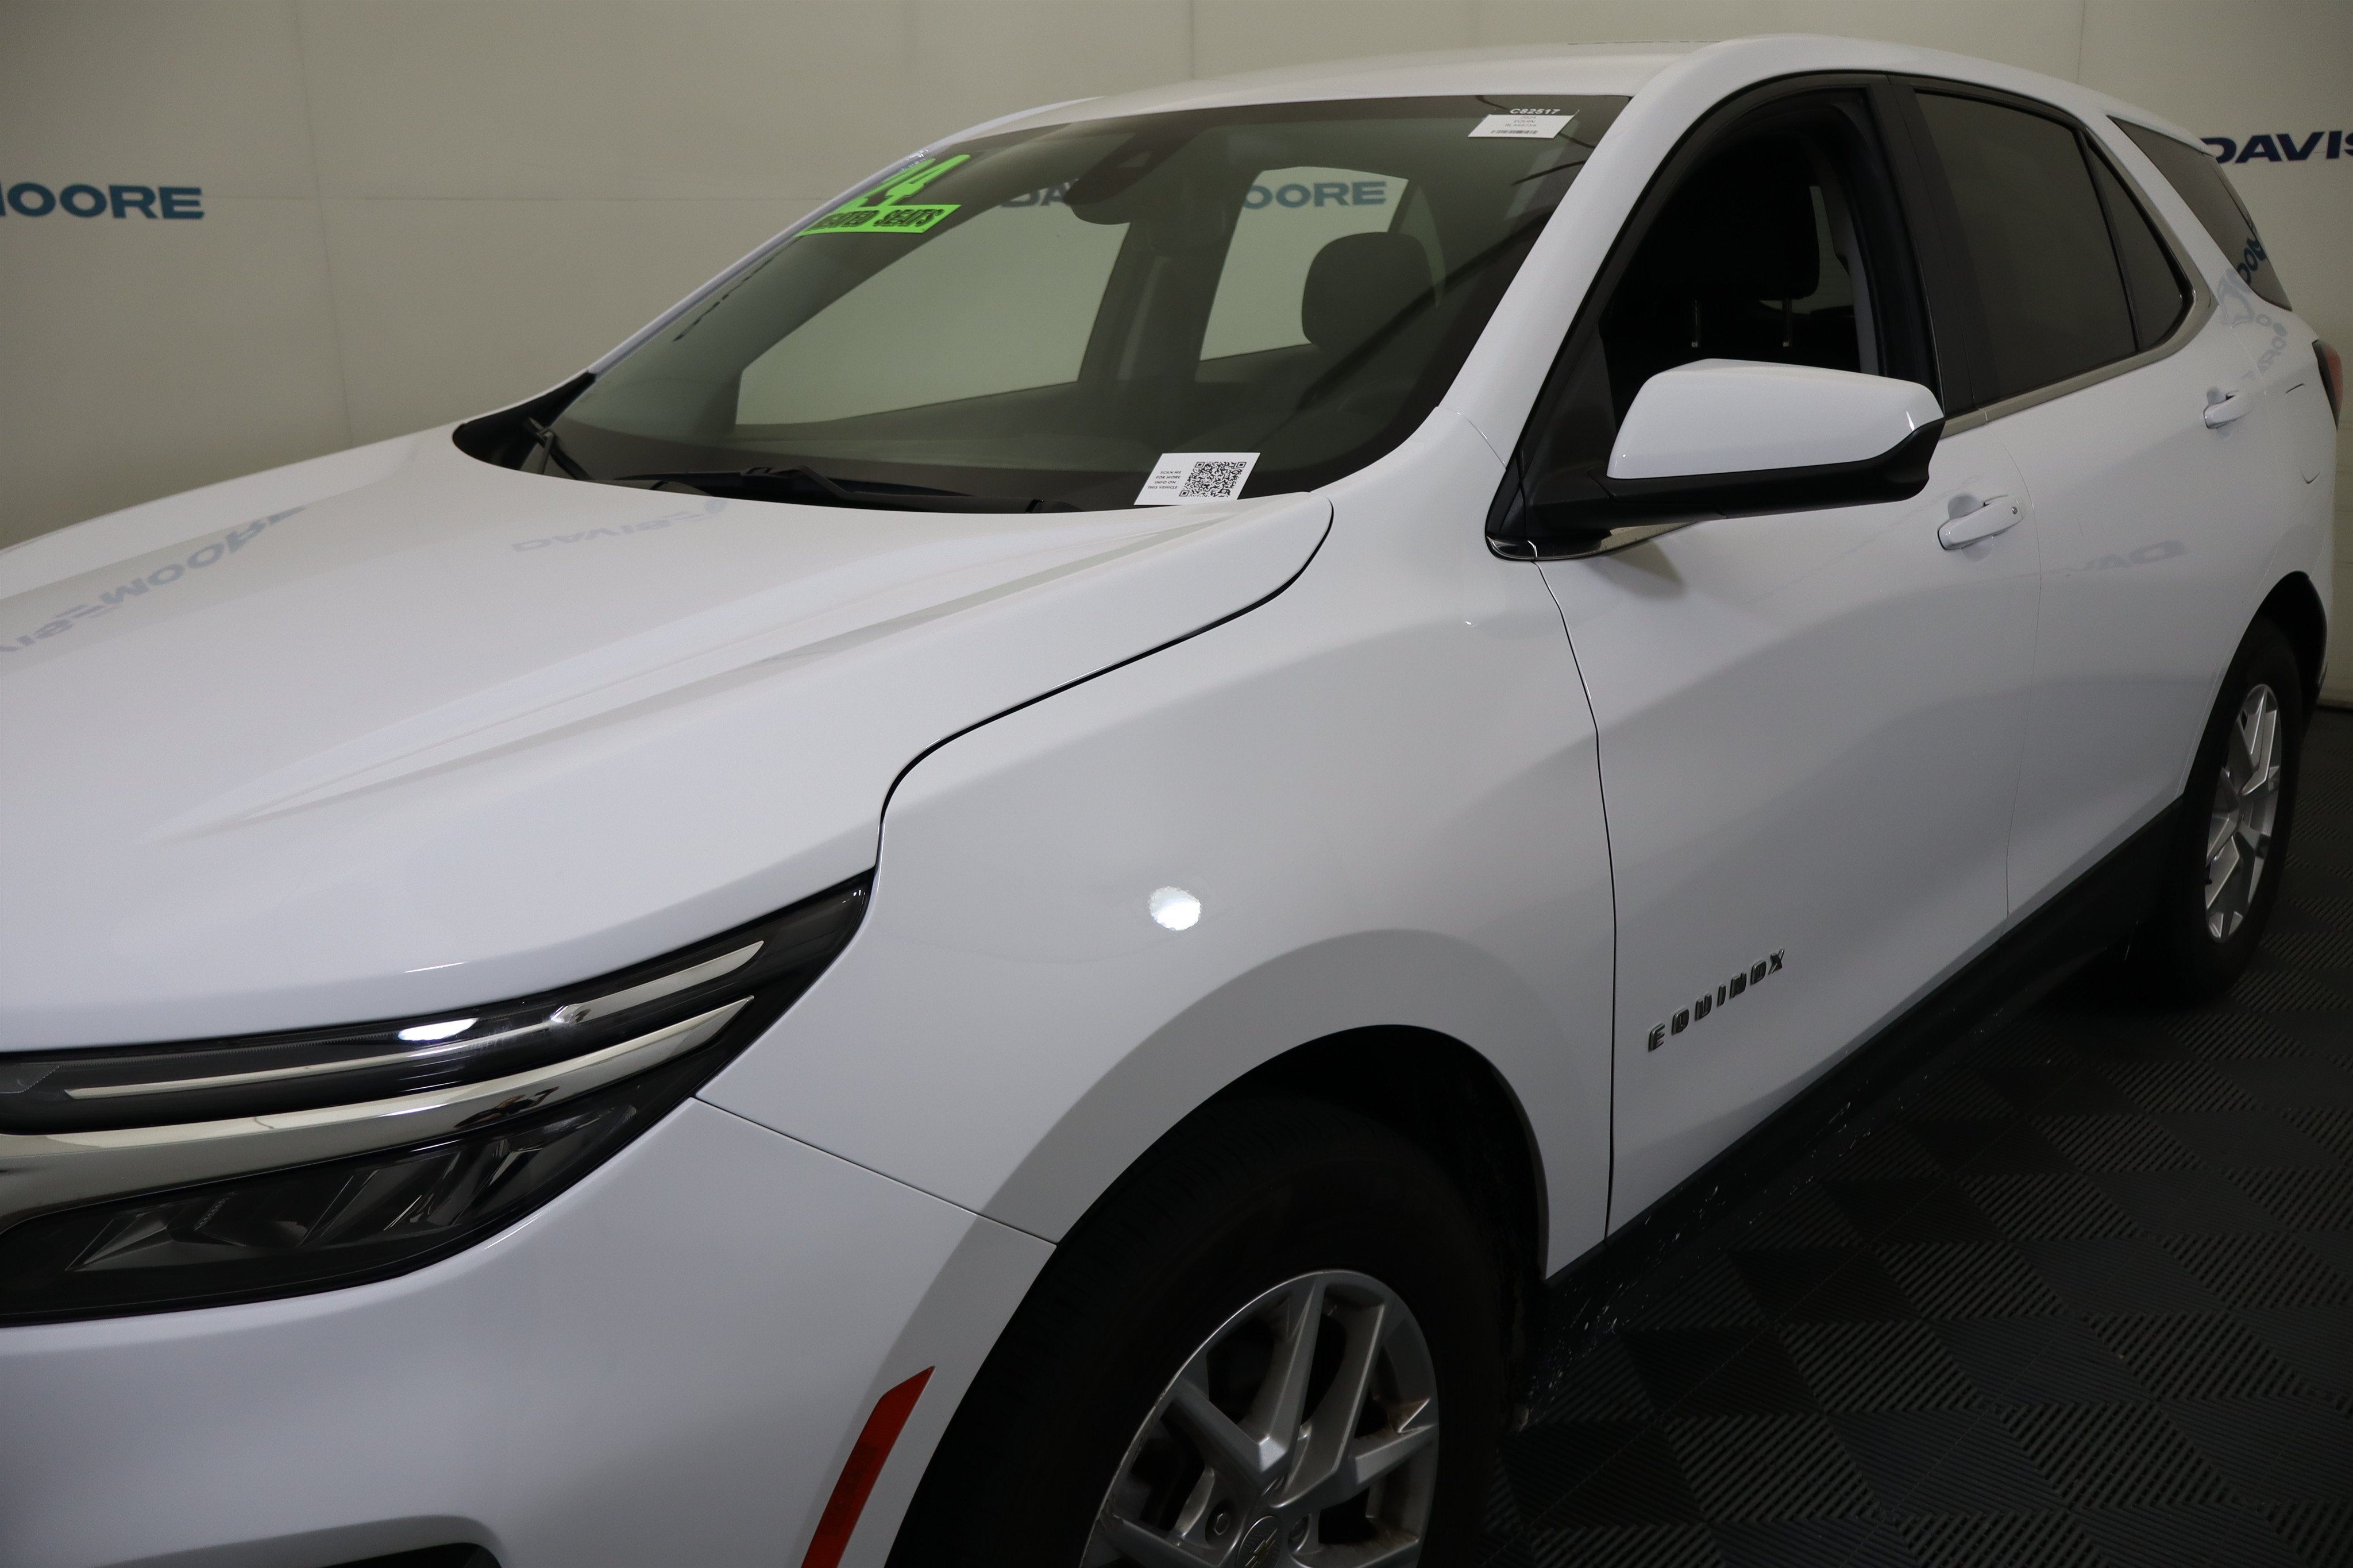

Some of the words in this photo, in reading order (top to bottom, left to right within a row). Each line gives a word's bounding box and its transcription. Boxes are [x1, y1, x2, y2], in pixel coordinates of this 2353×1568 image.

[0, 182, 205, 219] OORE
[873, 209, 944, 226] SEATS
[1648, 949, 1785, 1052] EQUINOX
